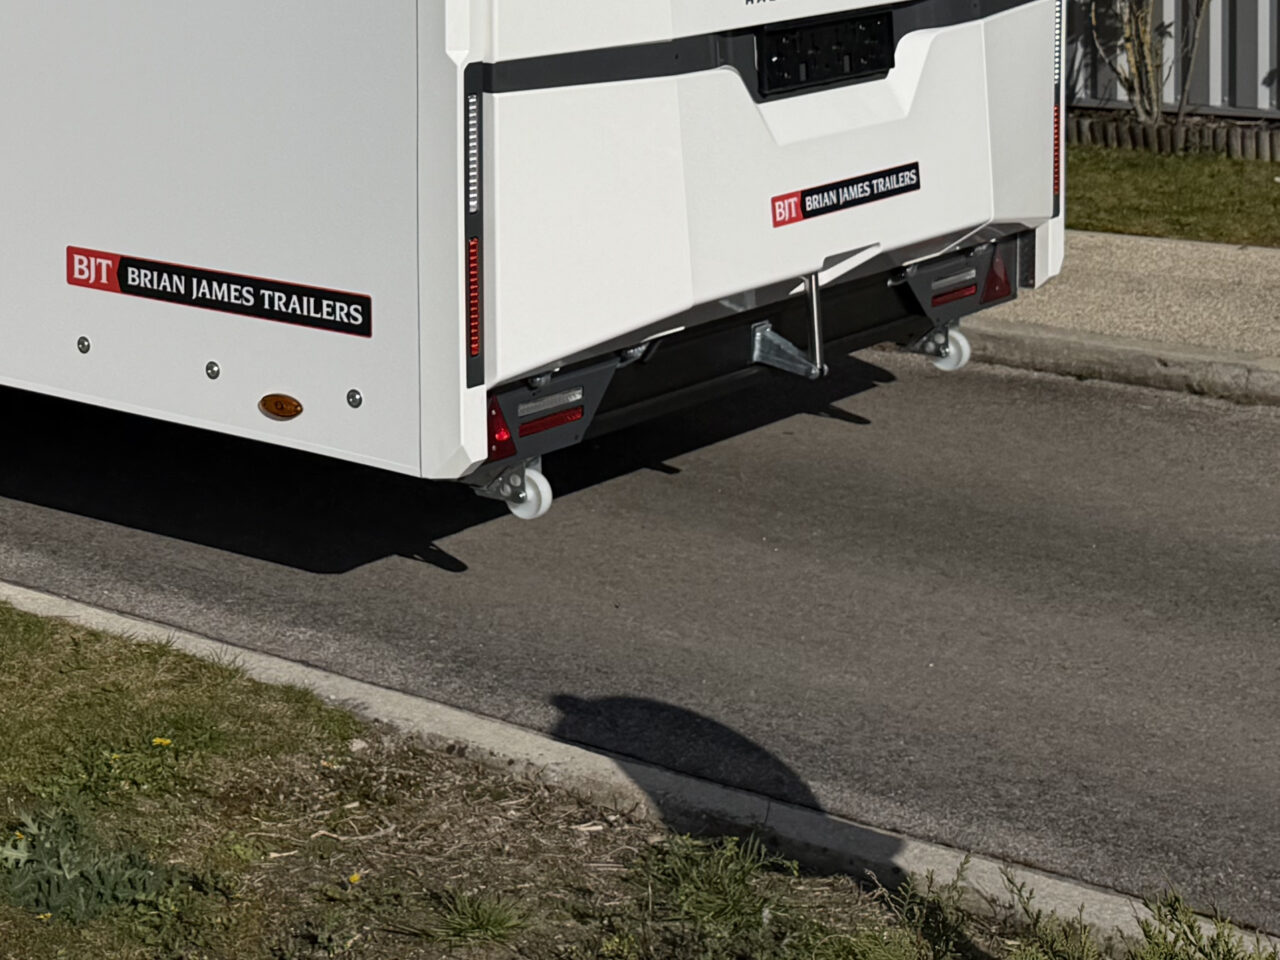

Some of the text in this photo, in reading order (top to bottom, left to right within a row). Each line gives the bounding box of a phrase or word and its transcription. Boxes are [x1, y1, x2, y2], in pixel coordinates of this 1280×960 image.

[774, 168, 917, 222] BJT BRIAN JAMES TRAILERS
[72, 253, 364, 326] BJT BRIAN JAMES TRAILERS
